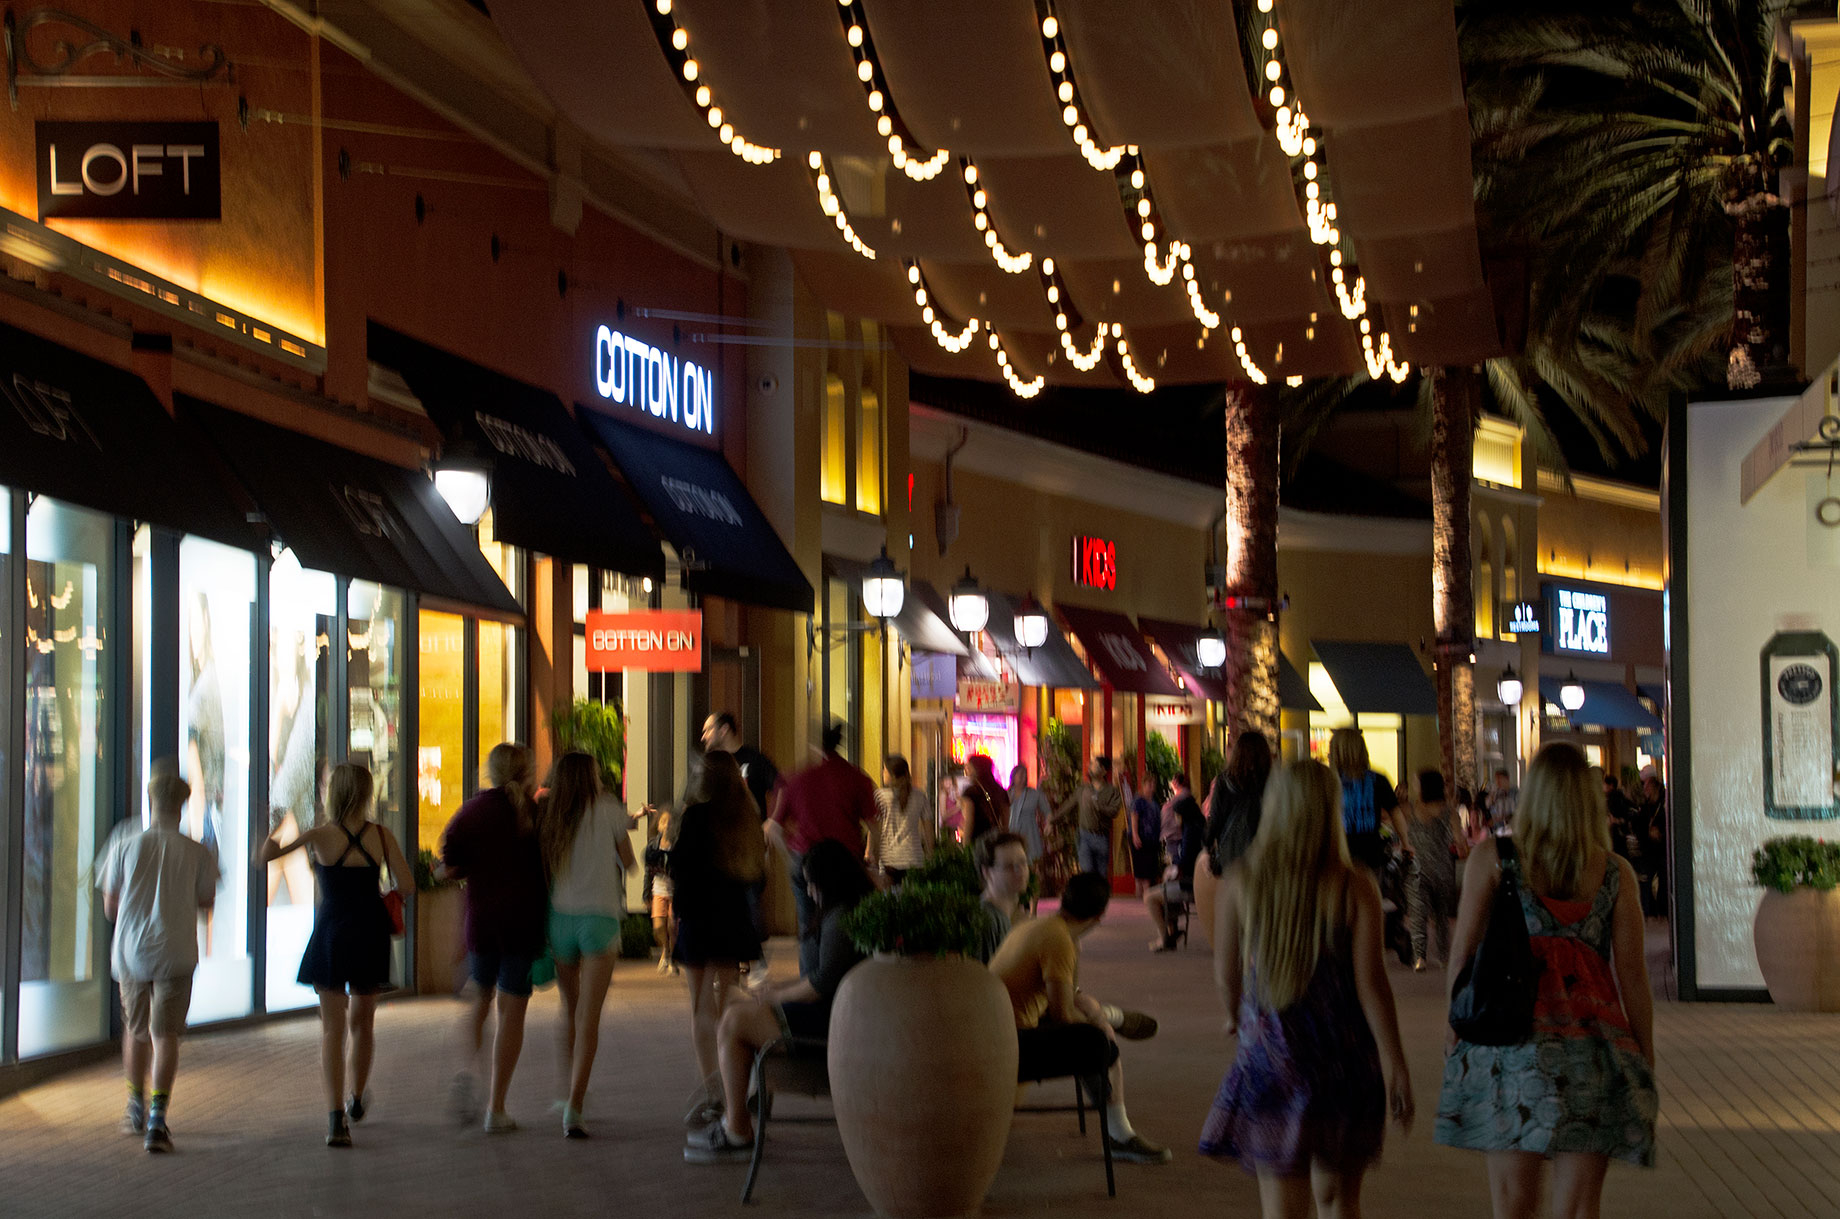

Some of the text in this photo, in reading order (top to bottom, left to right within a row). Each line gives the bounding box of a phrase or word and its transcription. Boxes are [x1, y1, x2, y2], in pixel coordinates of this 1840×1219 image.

[50, 143, 204, 196] LOFT
[596, 324, 713, 435] COTTON ON
[1082, 535, 1117, 592] KIDS
[593, 629, 693, 651] COTTON ON
[1558, 607, 1608, 654] PLACE
